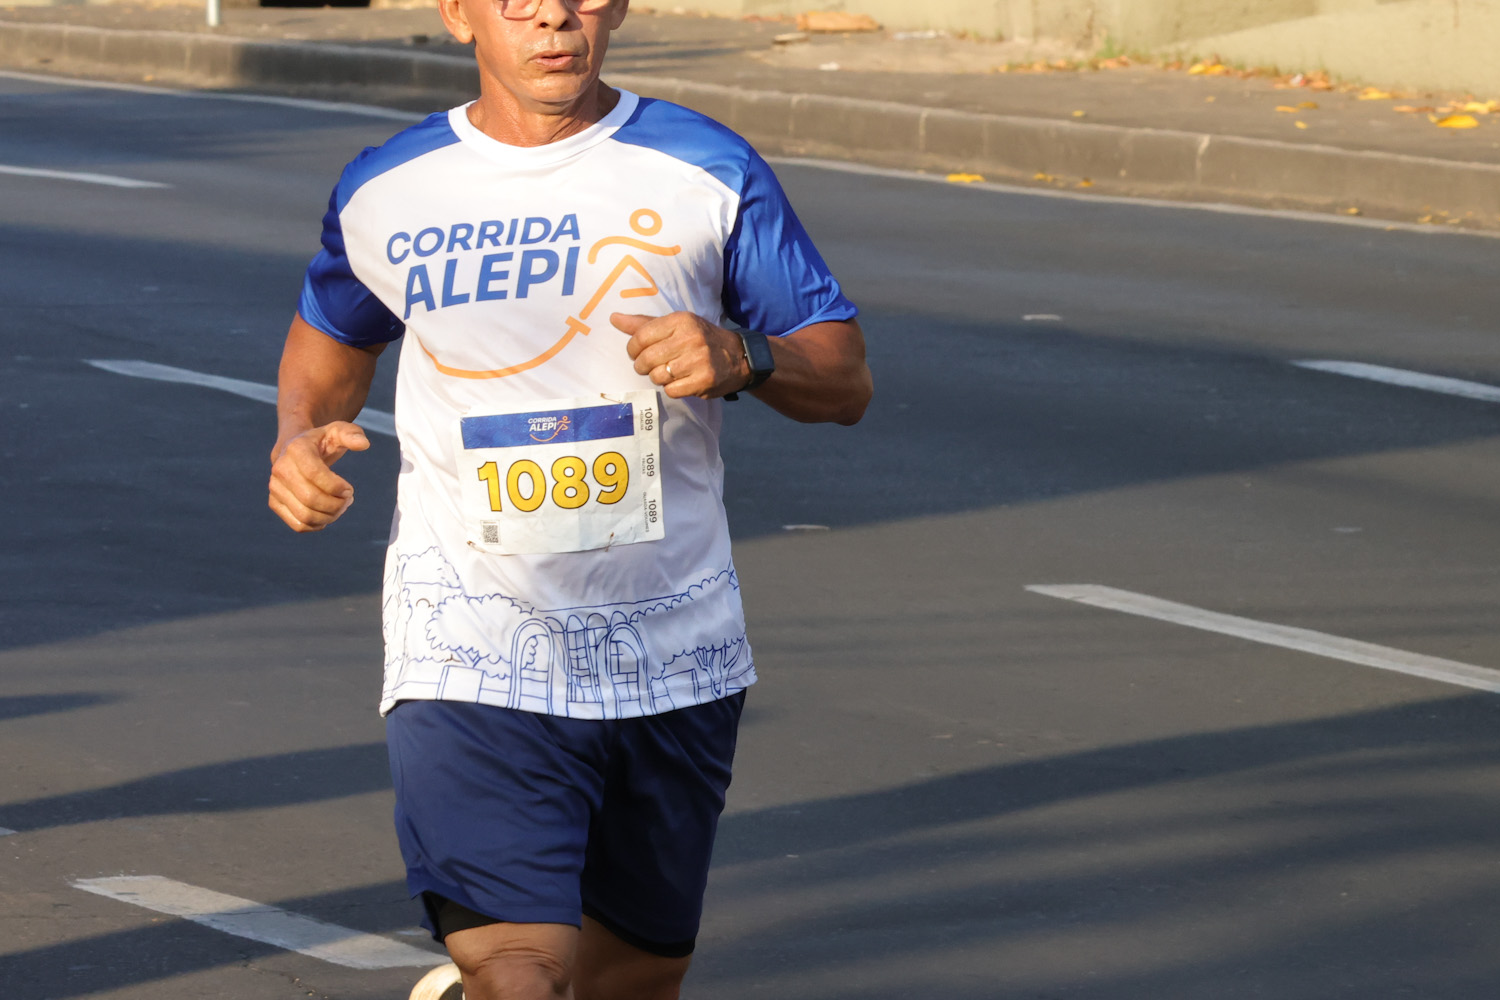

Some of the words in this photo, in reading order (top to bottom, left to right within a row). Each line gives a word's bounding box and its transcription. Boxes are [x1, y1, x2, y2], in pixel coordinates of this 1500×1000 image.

[387, 213, 581, 266] CORRIDA
[403, 246, 582, 320] ALEPI
[527, 416, 558, 424] CORRIDA
[529, 422, 558, 432] ALEPI
[644, 407, 653, 432] 1089
[646, 453, 655, 477] 1089
[476, 451, 630, 513] 1089
[648, 499, 658, 524] 1089
